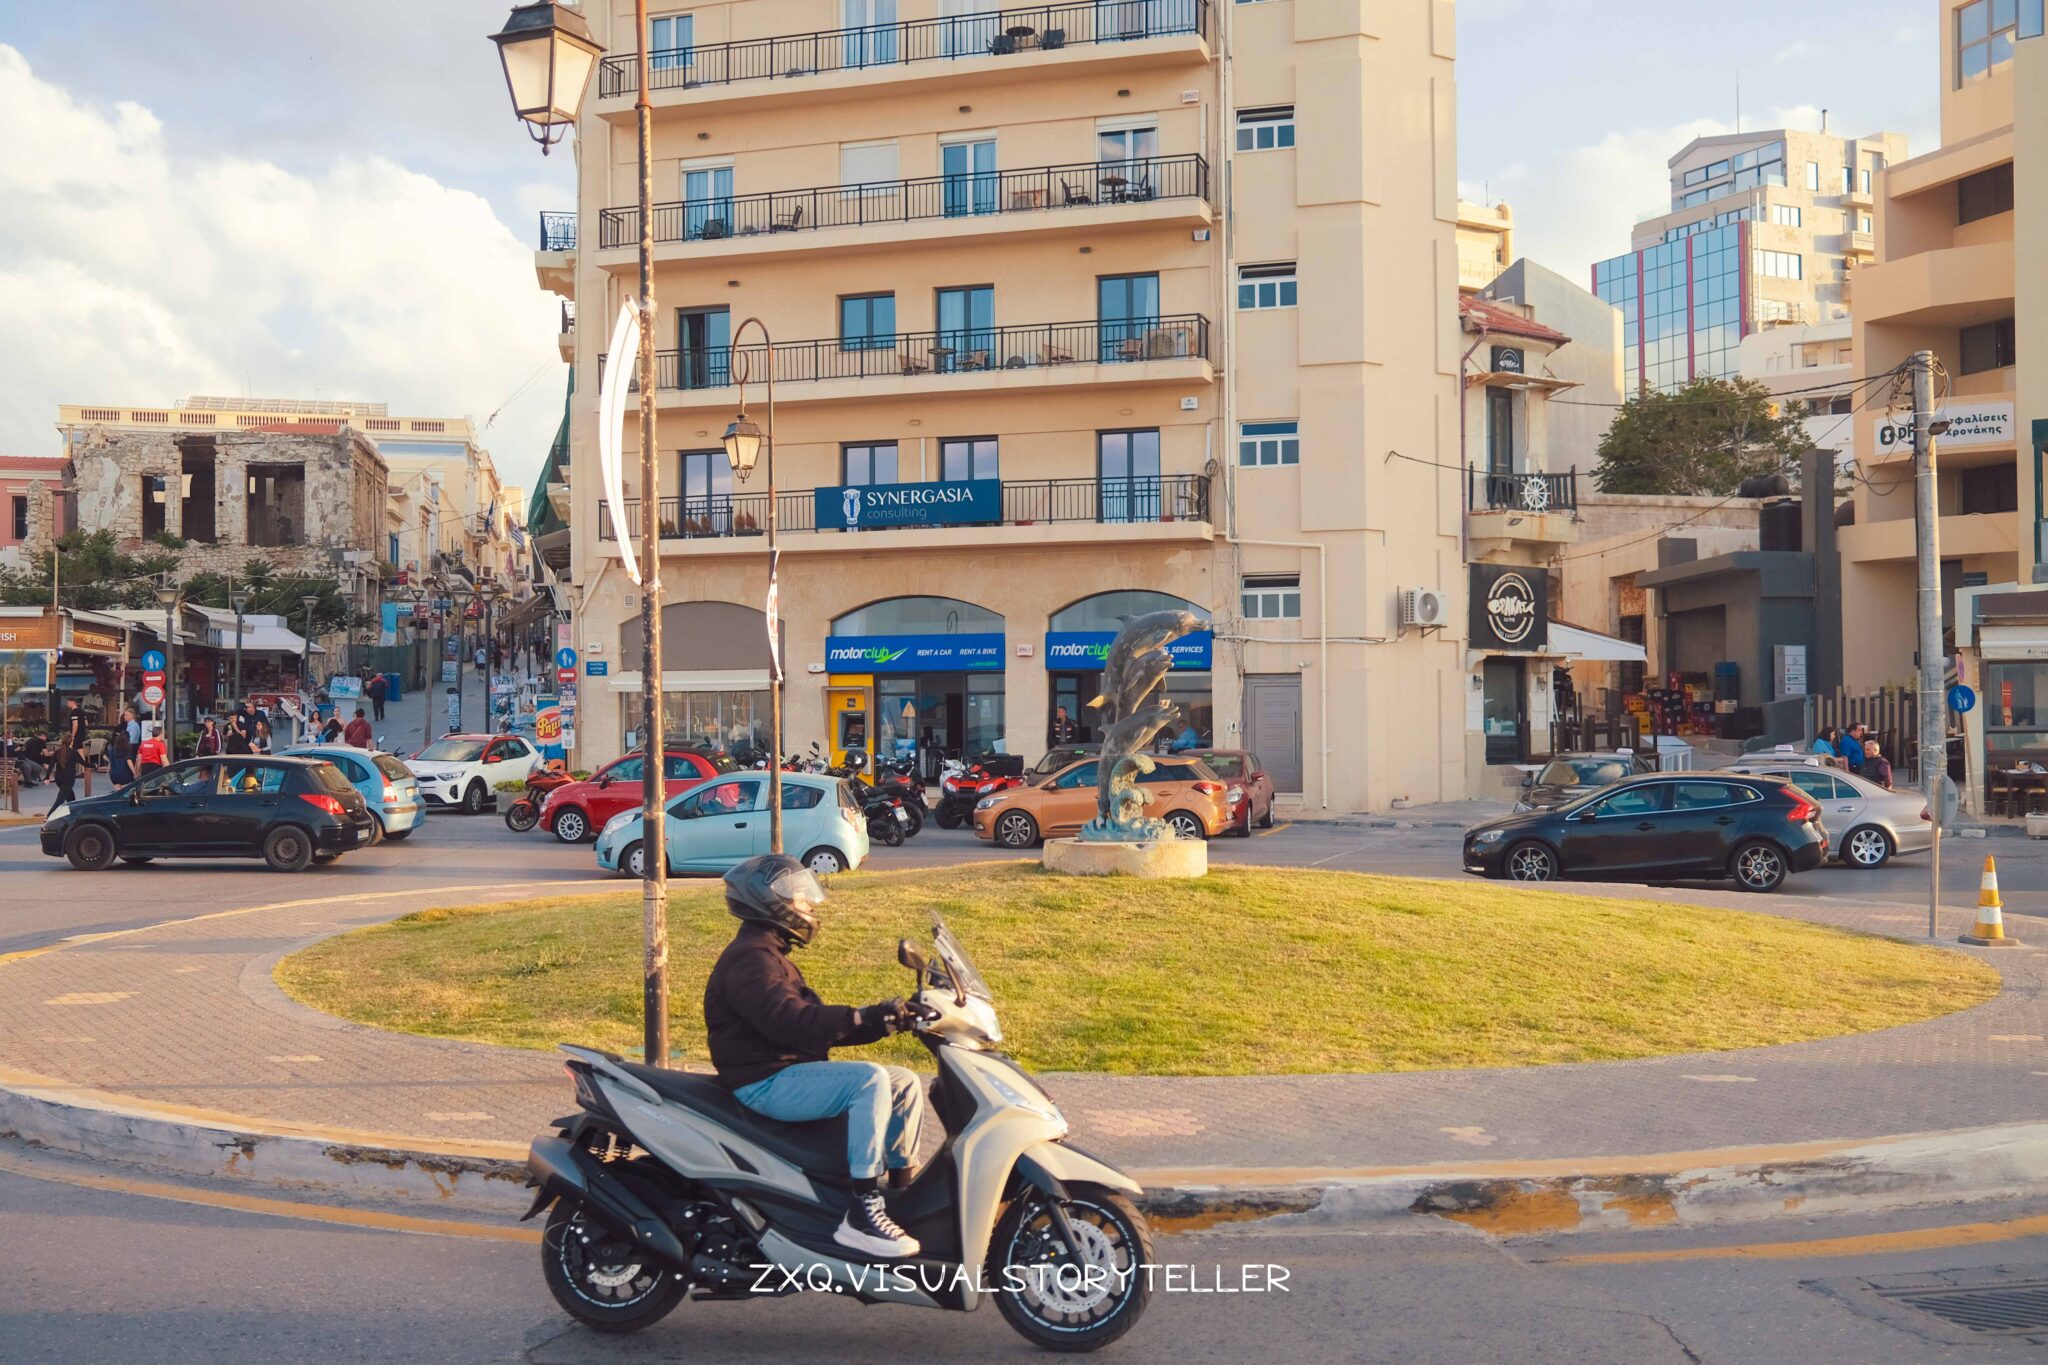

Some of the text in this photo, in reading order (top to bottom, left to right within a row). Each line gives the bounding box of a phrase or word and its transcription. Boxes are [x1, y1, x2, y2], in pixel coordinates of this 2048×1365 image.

[1948, 413, 2008, 427] σφαλίσεις
[867, 487, 974, 506] SYNERGASIA
[867, 507, 927, 520] consulting
[830, 646, 890, 660] motorclub
[917, 649, 934, 657] RENT
[939, 648, 953, 656] CAR
[959, 648, 976, 656] RENT
[982, 647, 998, 655] BIKE
[1171, 646, 1204, 654] SERVICES
